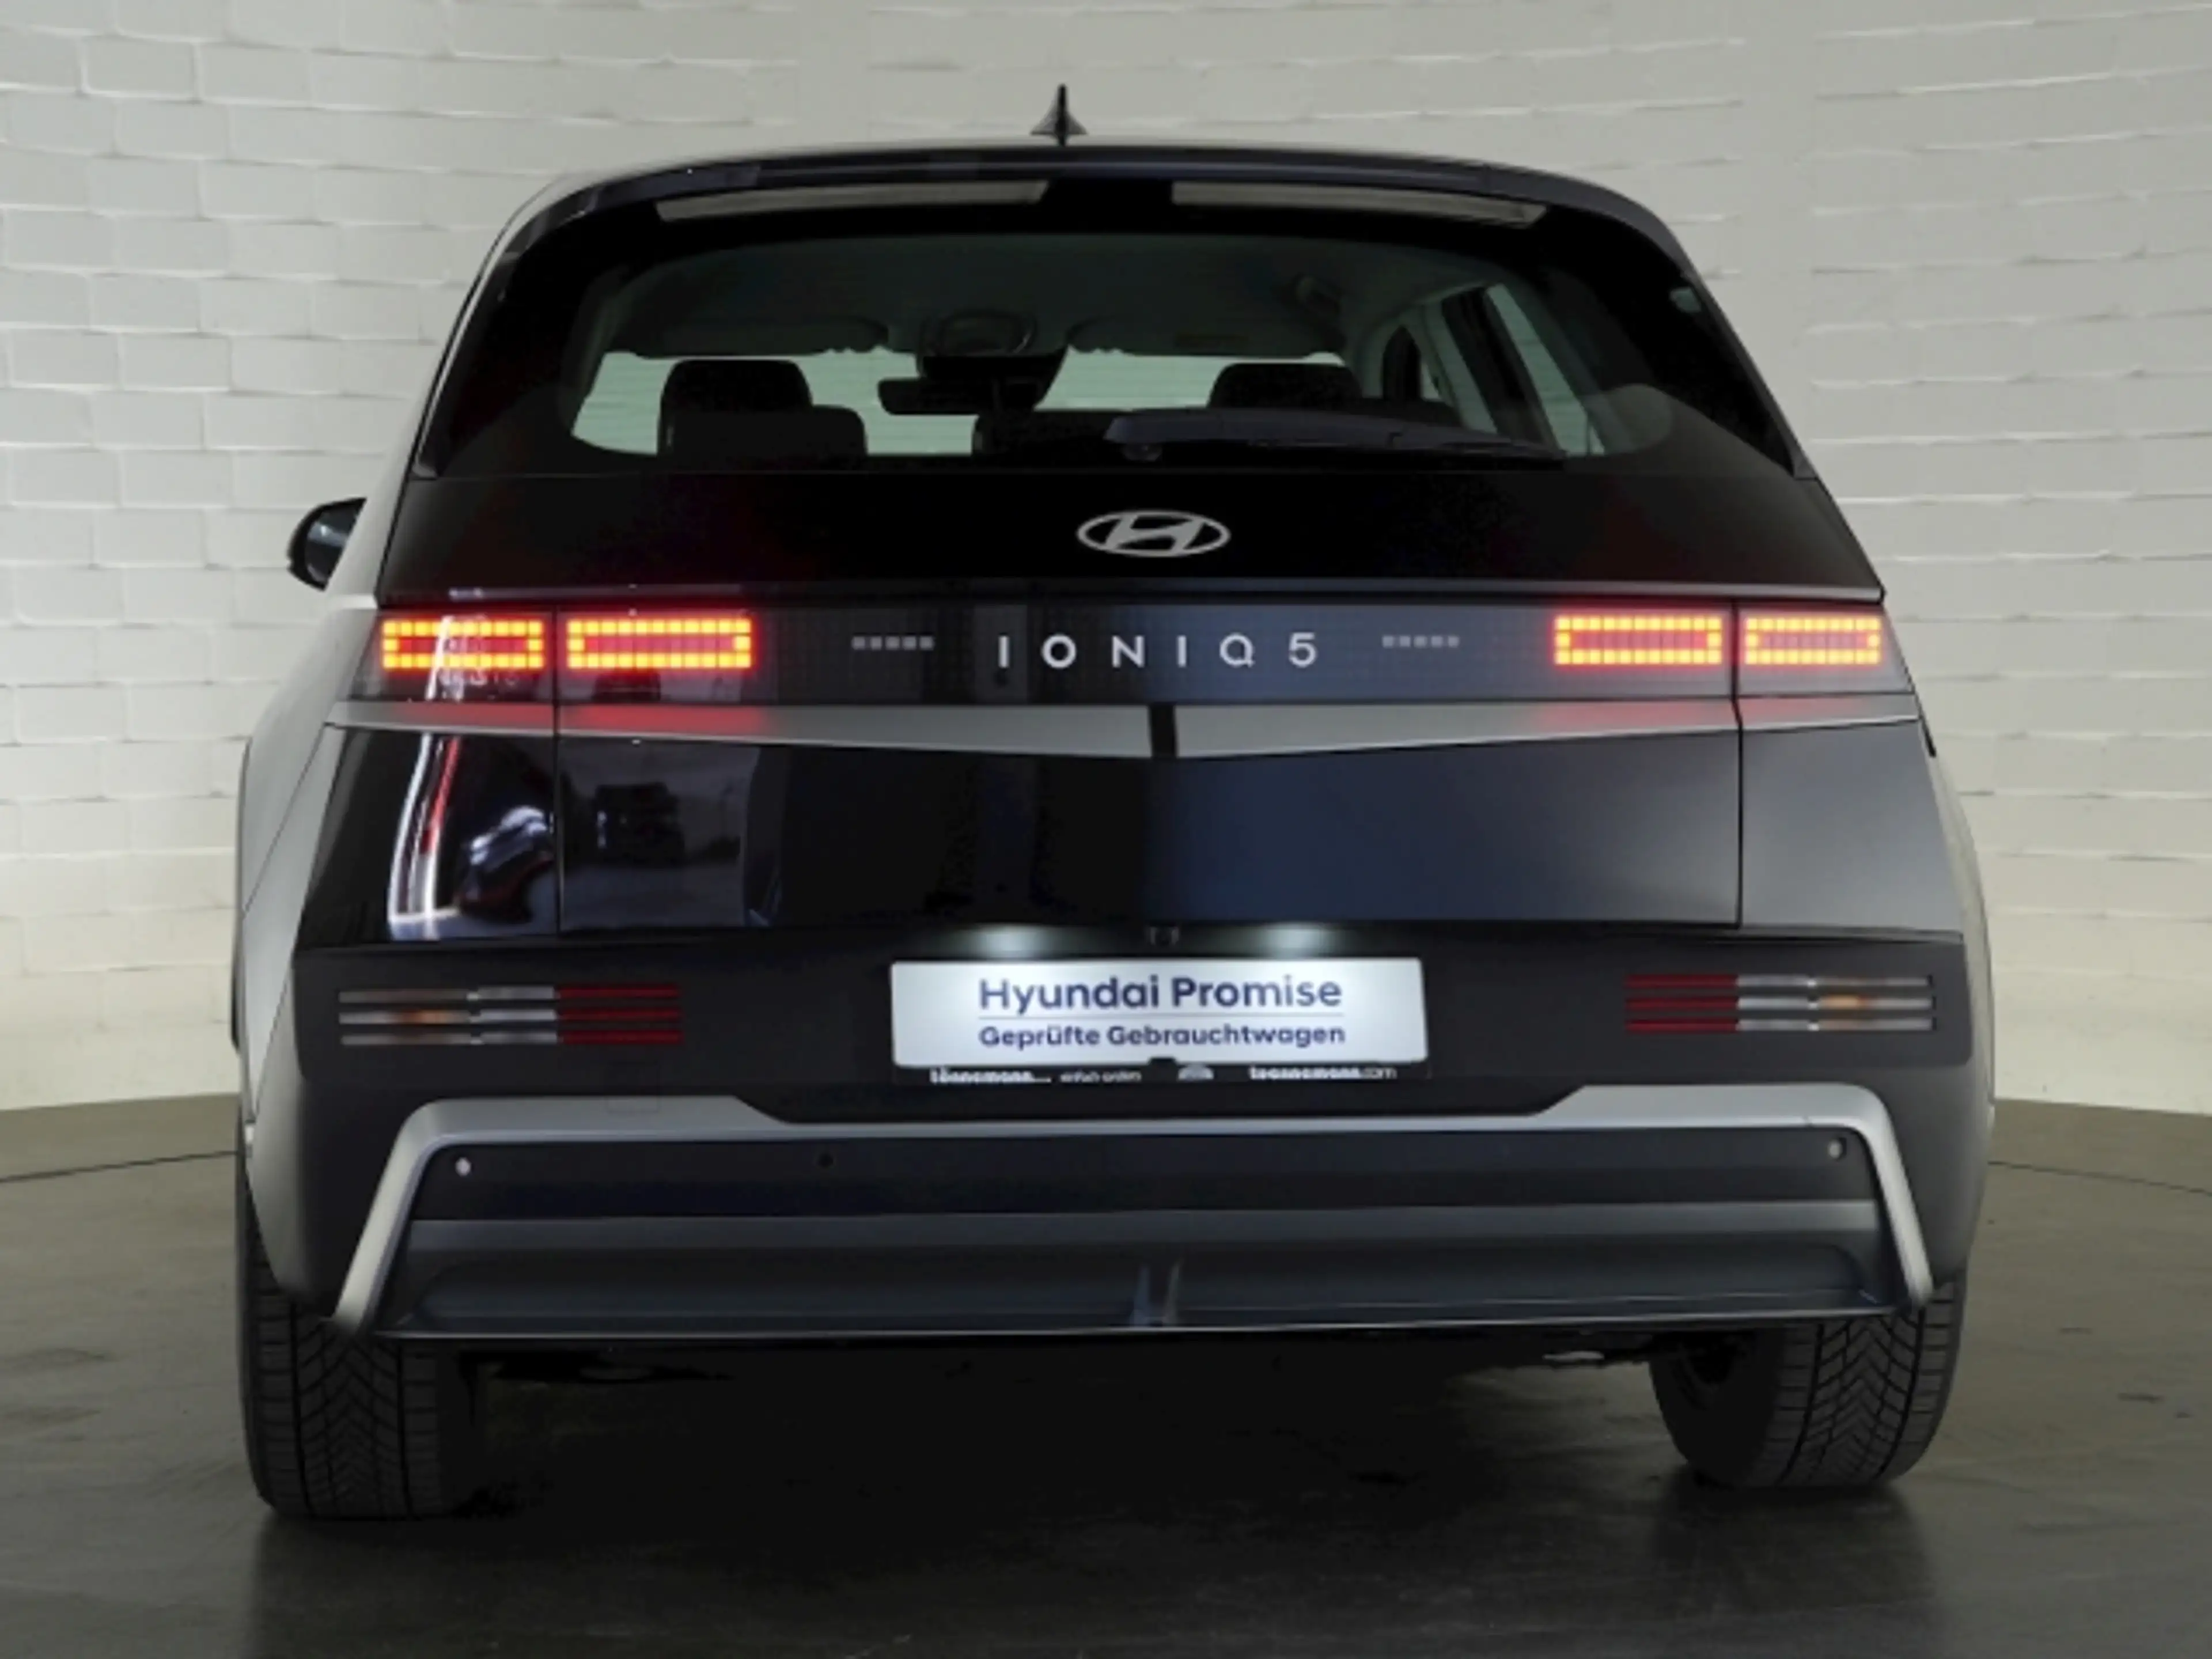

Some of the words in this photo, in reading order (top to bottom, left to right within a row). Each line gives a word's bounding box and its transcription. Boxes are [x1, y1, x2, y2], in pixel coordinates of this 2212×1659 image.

[998, 634, 1254, 669] IONIQ
[1289, 632, 1317, 668] 5
[979, 975, 1160, 1014] Hyundai
[1172, 977, 1343, 1008] Promise
[978, 1025, 1101, 1052] Geprüfte
[1106, 1024, 1346, 1049] Gebrauchtwagen
